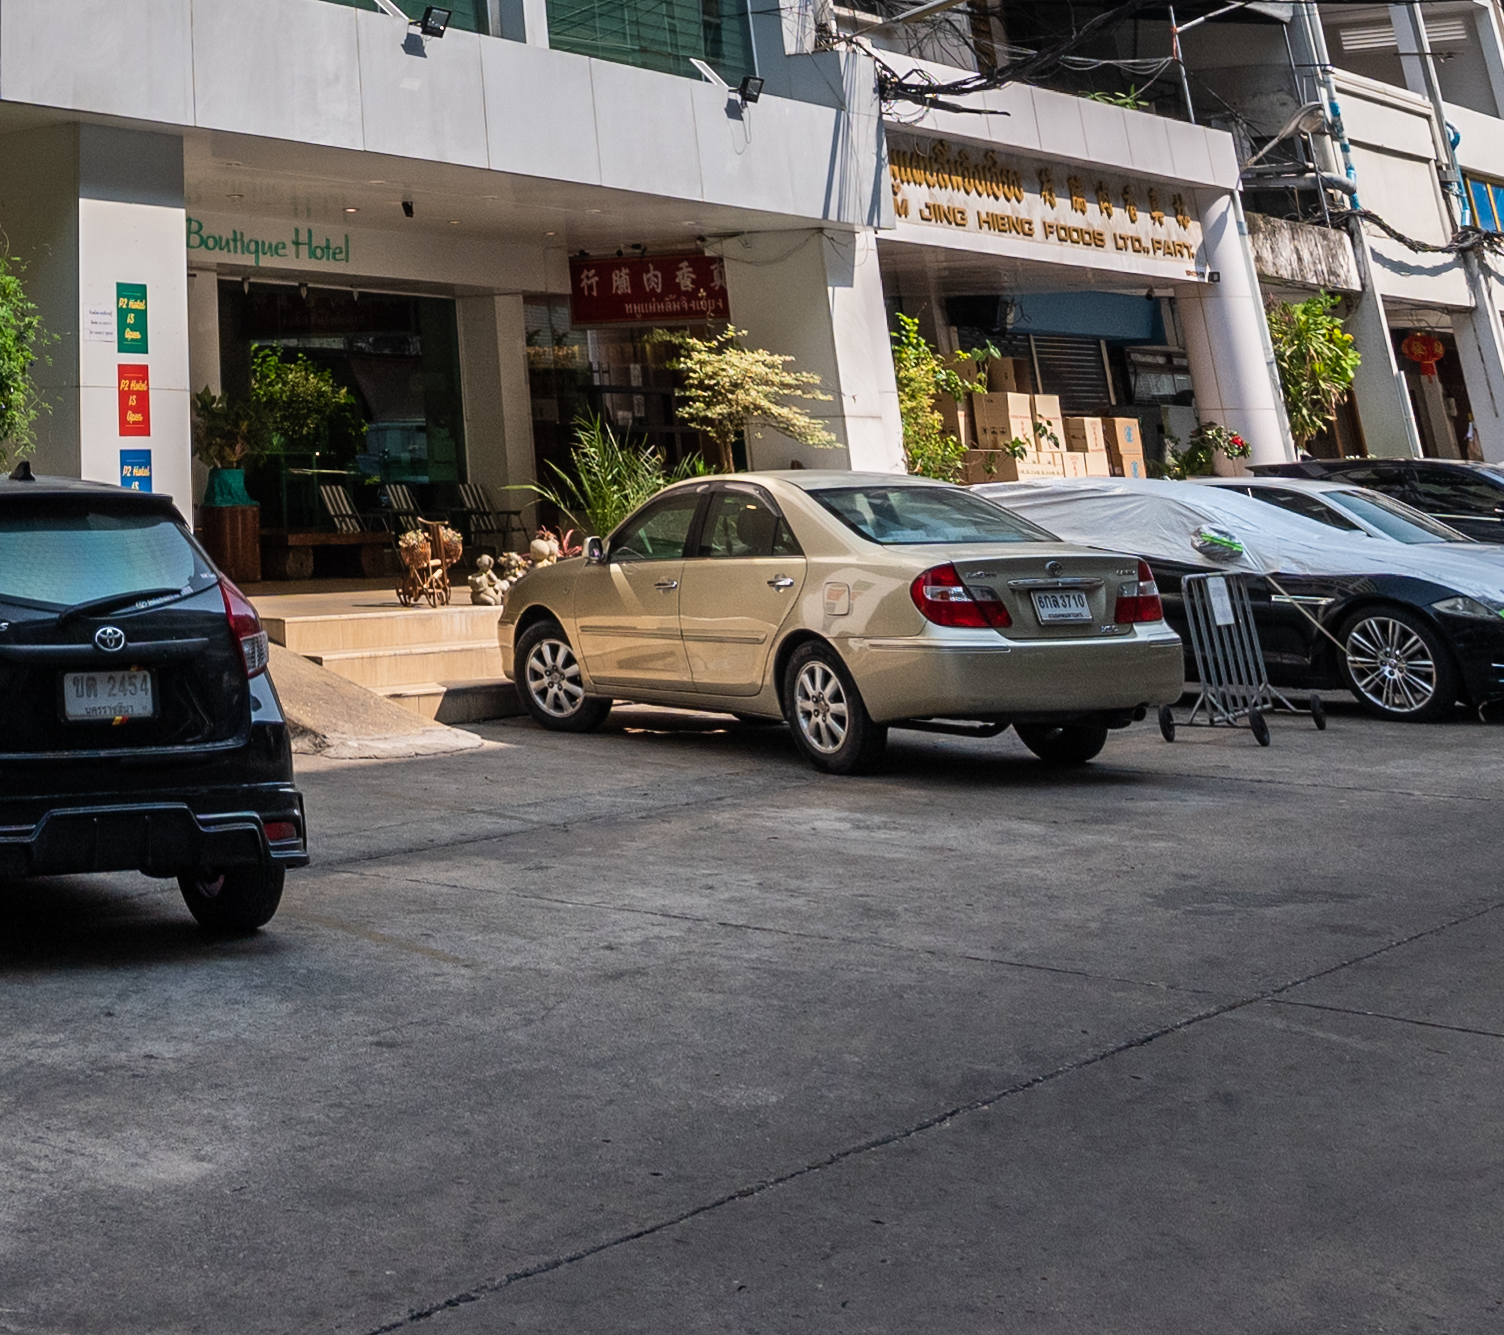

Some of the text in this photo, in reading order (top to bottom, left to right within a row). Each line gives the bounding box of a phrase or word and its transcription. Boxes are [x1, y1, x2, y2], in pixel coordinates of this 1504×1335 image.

[186, 217, 350, 267] Boutique Hotel
[920, 201, 969, 227] JING
[977, 210, 1036, 238] HIENG
[1043, 221, 1107, 249] FOODS
[106, 674, 150, 699] 2454
